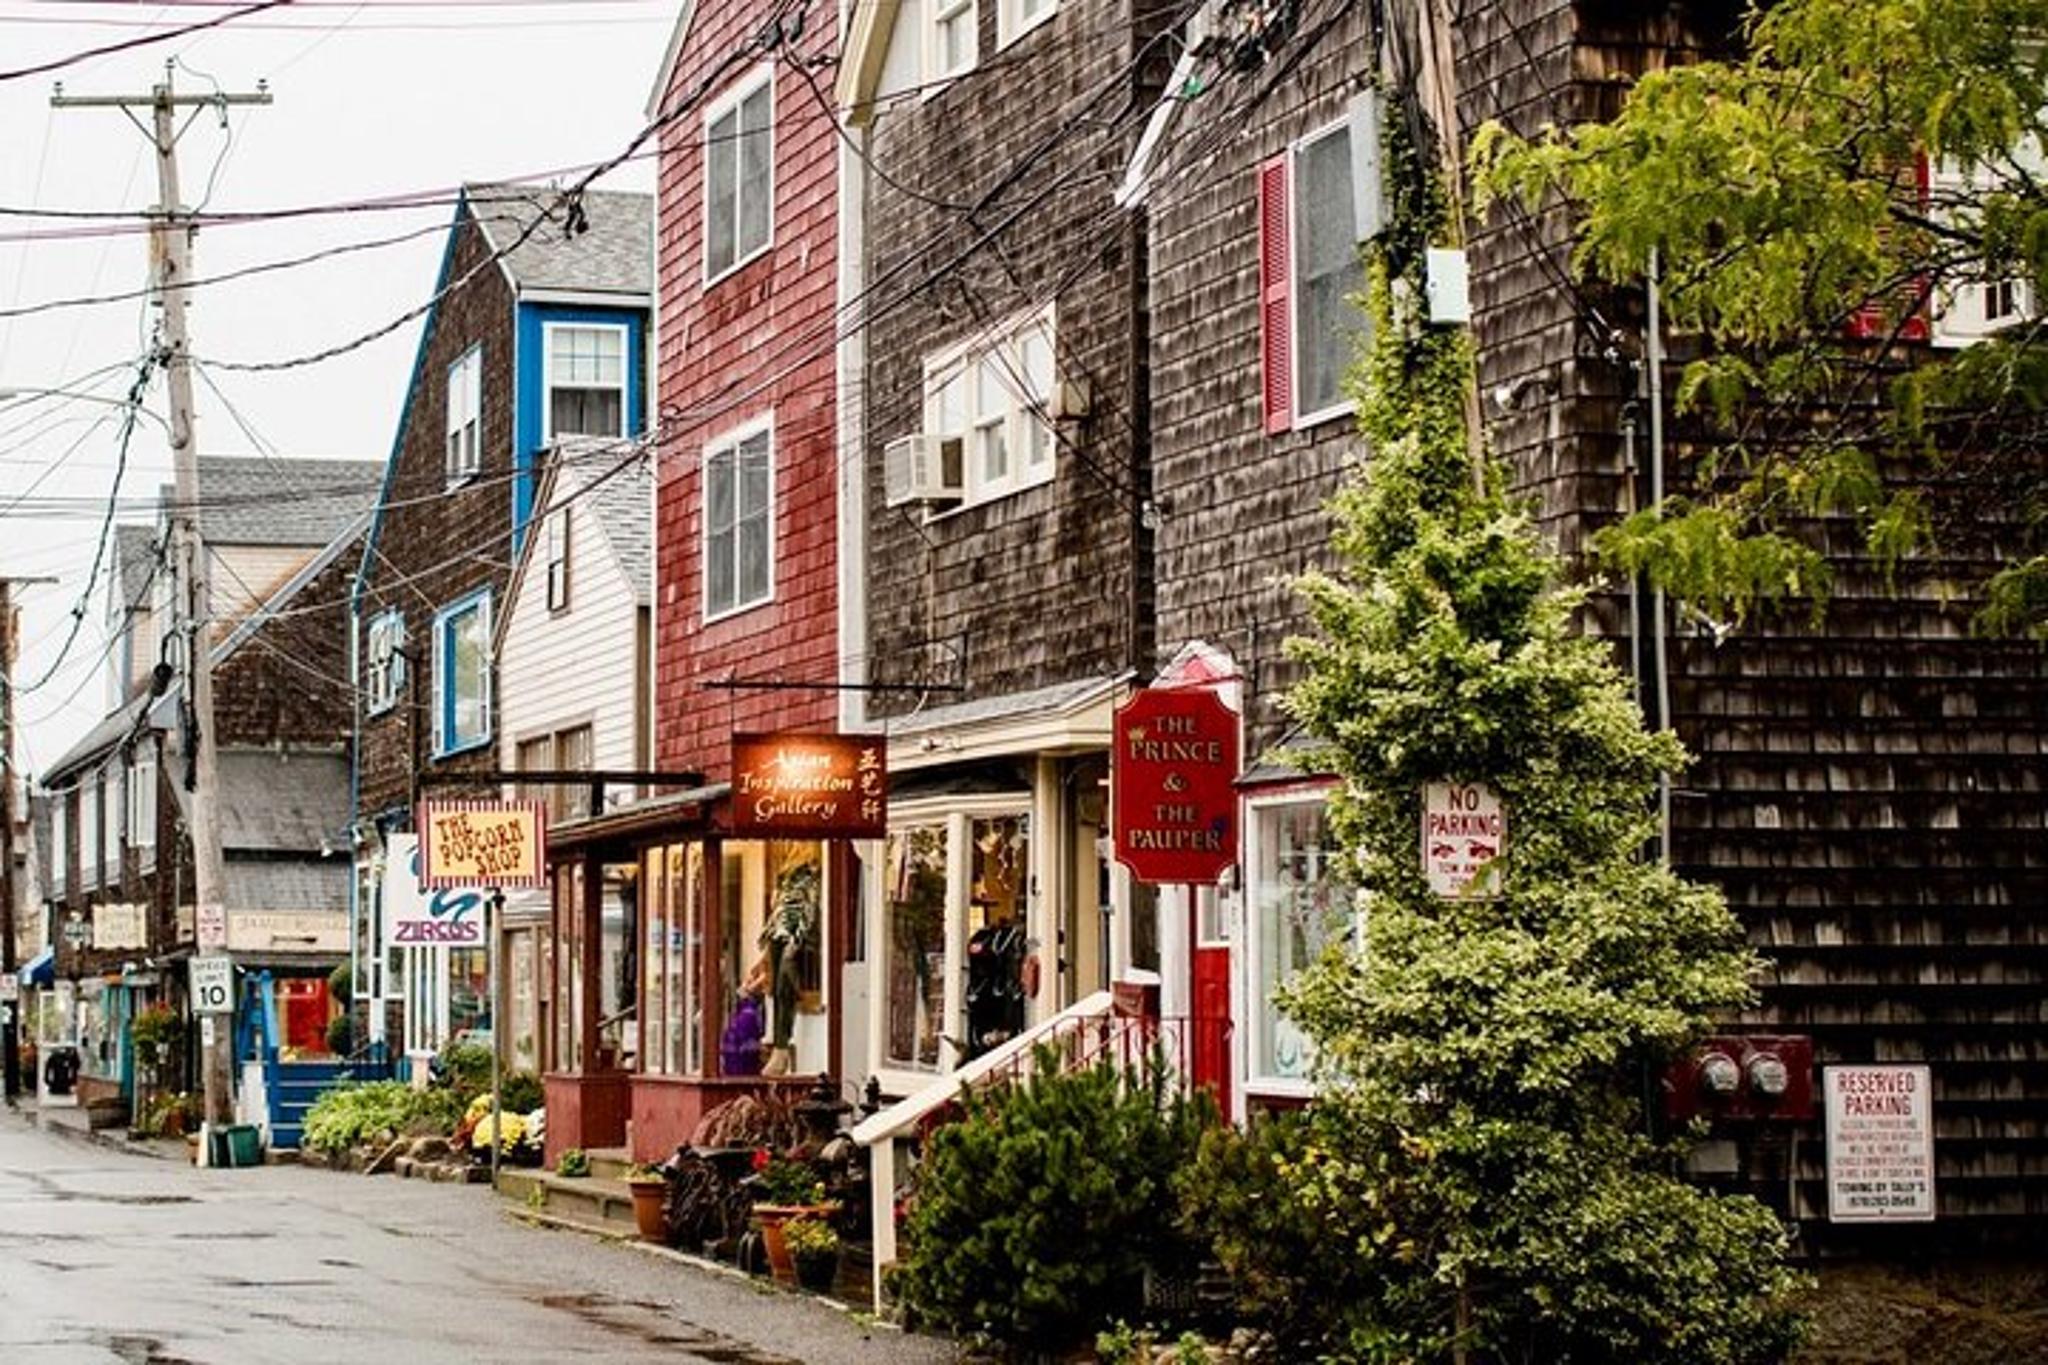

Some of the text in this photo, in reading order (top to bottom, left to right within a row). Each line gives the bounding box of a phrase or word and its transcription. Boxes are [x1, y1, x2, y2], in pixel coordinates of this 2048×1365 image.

[1154, 715, 1197, 735] THE
[1129, 740, 1222, 763] PRINCE
[738, 771, 854, 794] Inspiration
[1162, 772, 1187, 793] &
[754, 795, 838, 823] Gallery
[1449, 787, 1480, 812] NO
[1154, 803, 1197, 823] THE
[1429, 813, 1500, 836] PARKING
[435, 813, 474, 842] THE
[439, 818, 525, 868] POPCORN
[1128, 828, 1222, 852] PAUPER
[475, 846, 522, 875] SHOP
[201, 985, 226, 1006] 10
[1837, 1072, 1915, 1094] RESERVED
[1844, 1095, 1911, 1116] PARKING
